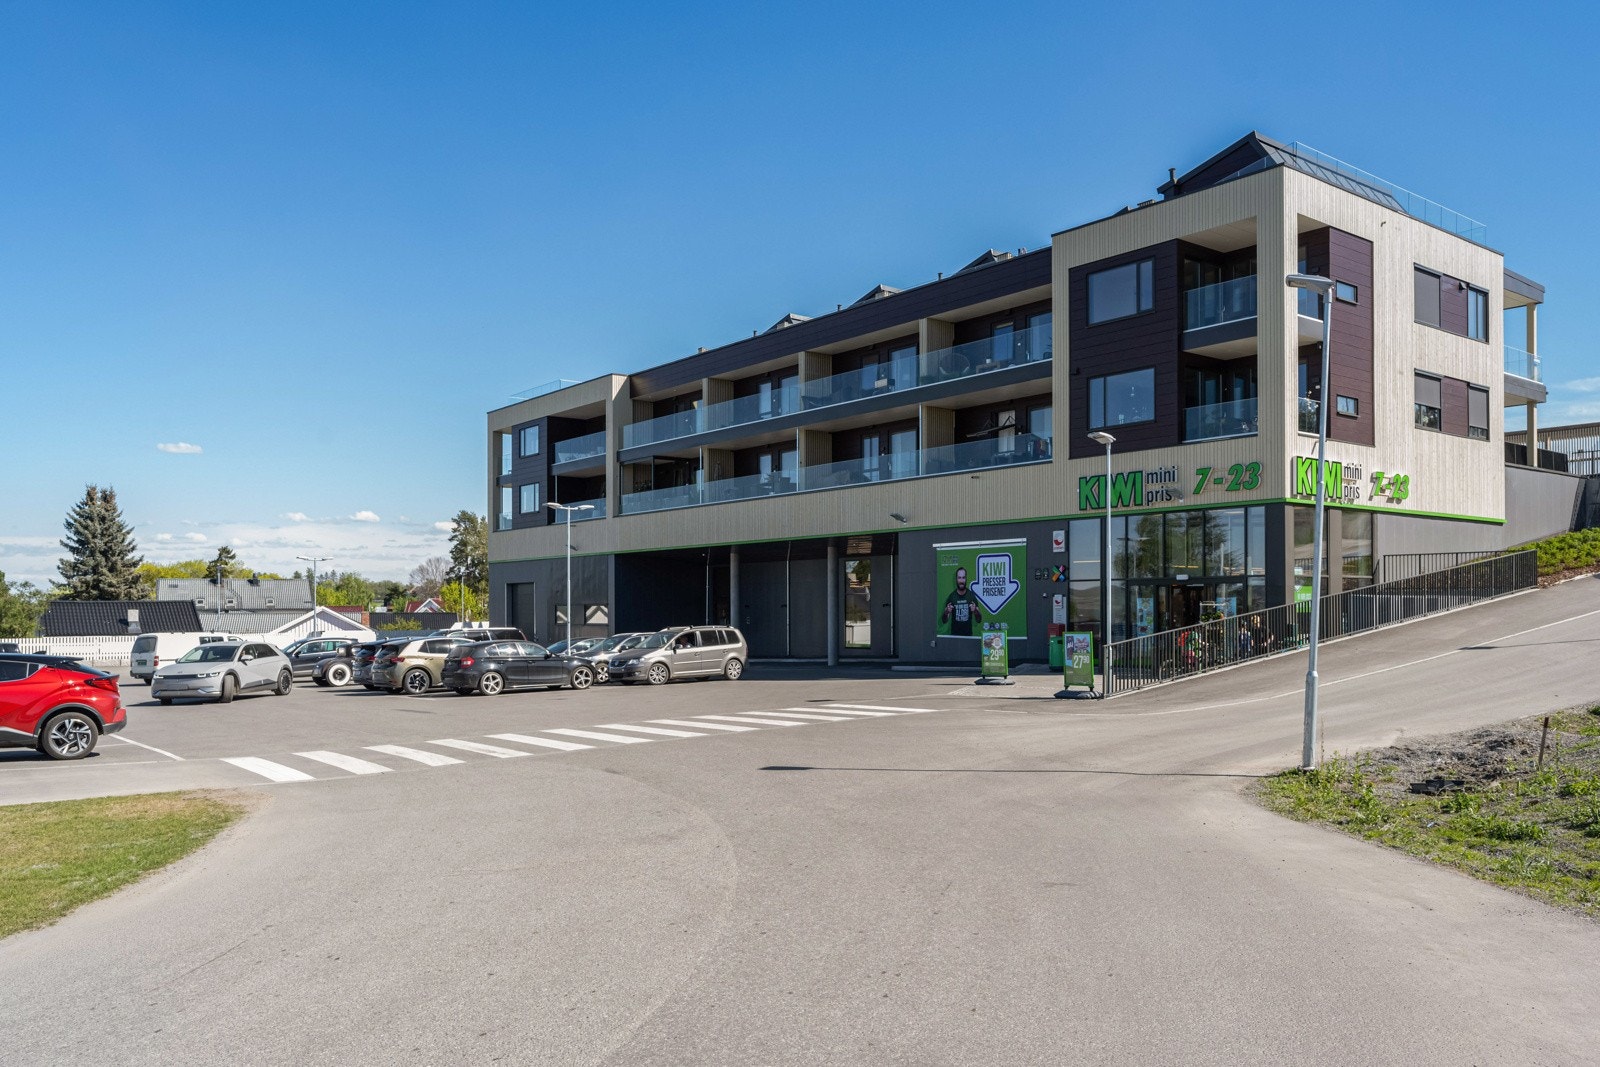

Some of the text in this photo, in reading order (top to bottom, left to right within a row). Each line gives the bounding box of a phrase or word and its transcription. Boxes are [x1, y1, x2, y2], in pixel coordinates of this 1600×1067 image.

[1146, 465, 1178, 484] mini
[1295, 456, 1342, 499] KIWI
[1343, 463, 1362, 480] mini
[1079, 470, 1143, 511] KIWI
[1146, 486, 1173, 506] pris
[1343, 483, 1360, 500] pris
[982, 562, 1006, 576] KIWI
[982, 577, 1006, 587] PRESSER
[982, 587, 1006, 597] PRISENE!
